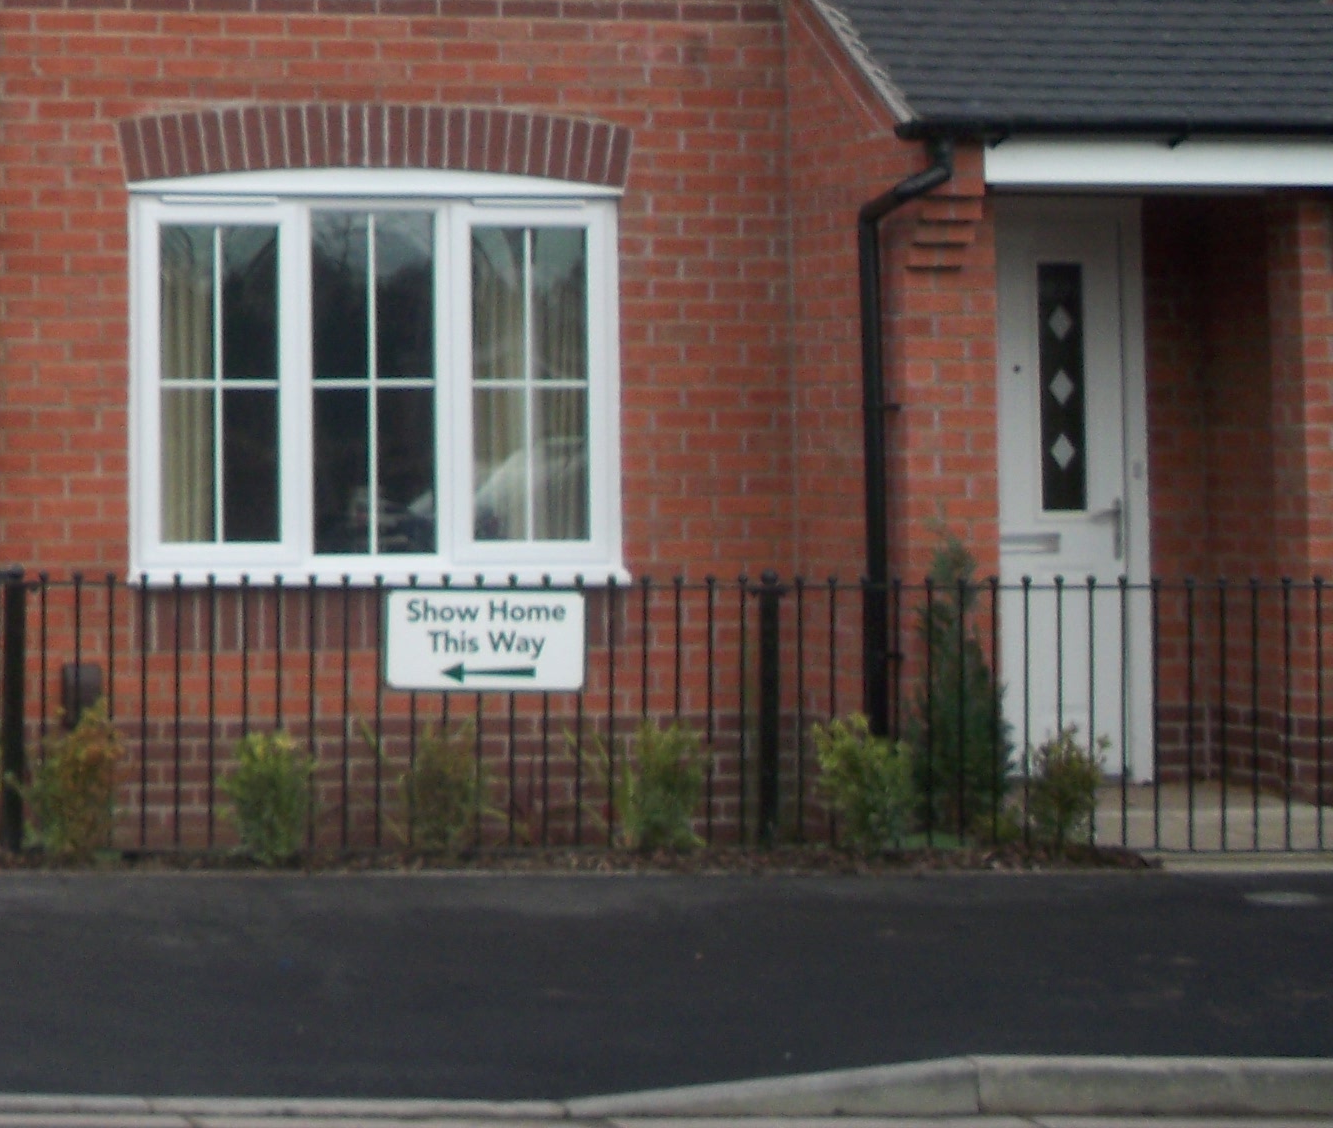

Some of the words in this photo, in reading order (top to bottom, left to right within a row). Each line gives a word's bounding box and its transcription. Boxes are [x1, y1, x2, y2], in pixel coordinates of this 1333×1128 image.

[406, 598, 480, 622] Show
[488, 599, 567, 622] Home
[428, 630, 480, 653] This
[489, 631, 545, 660] Way
